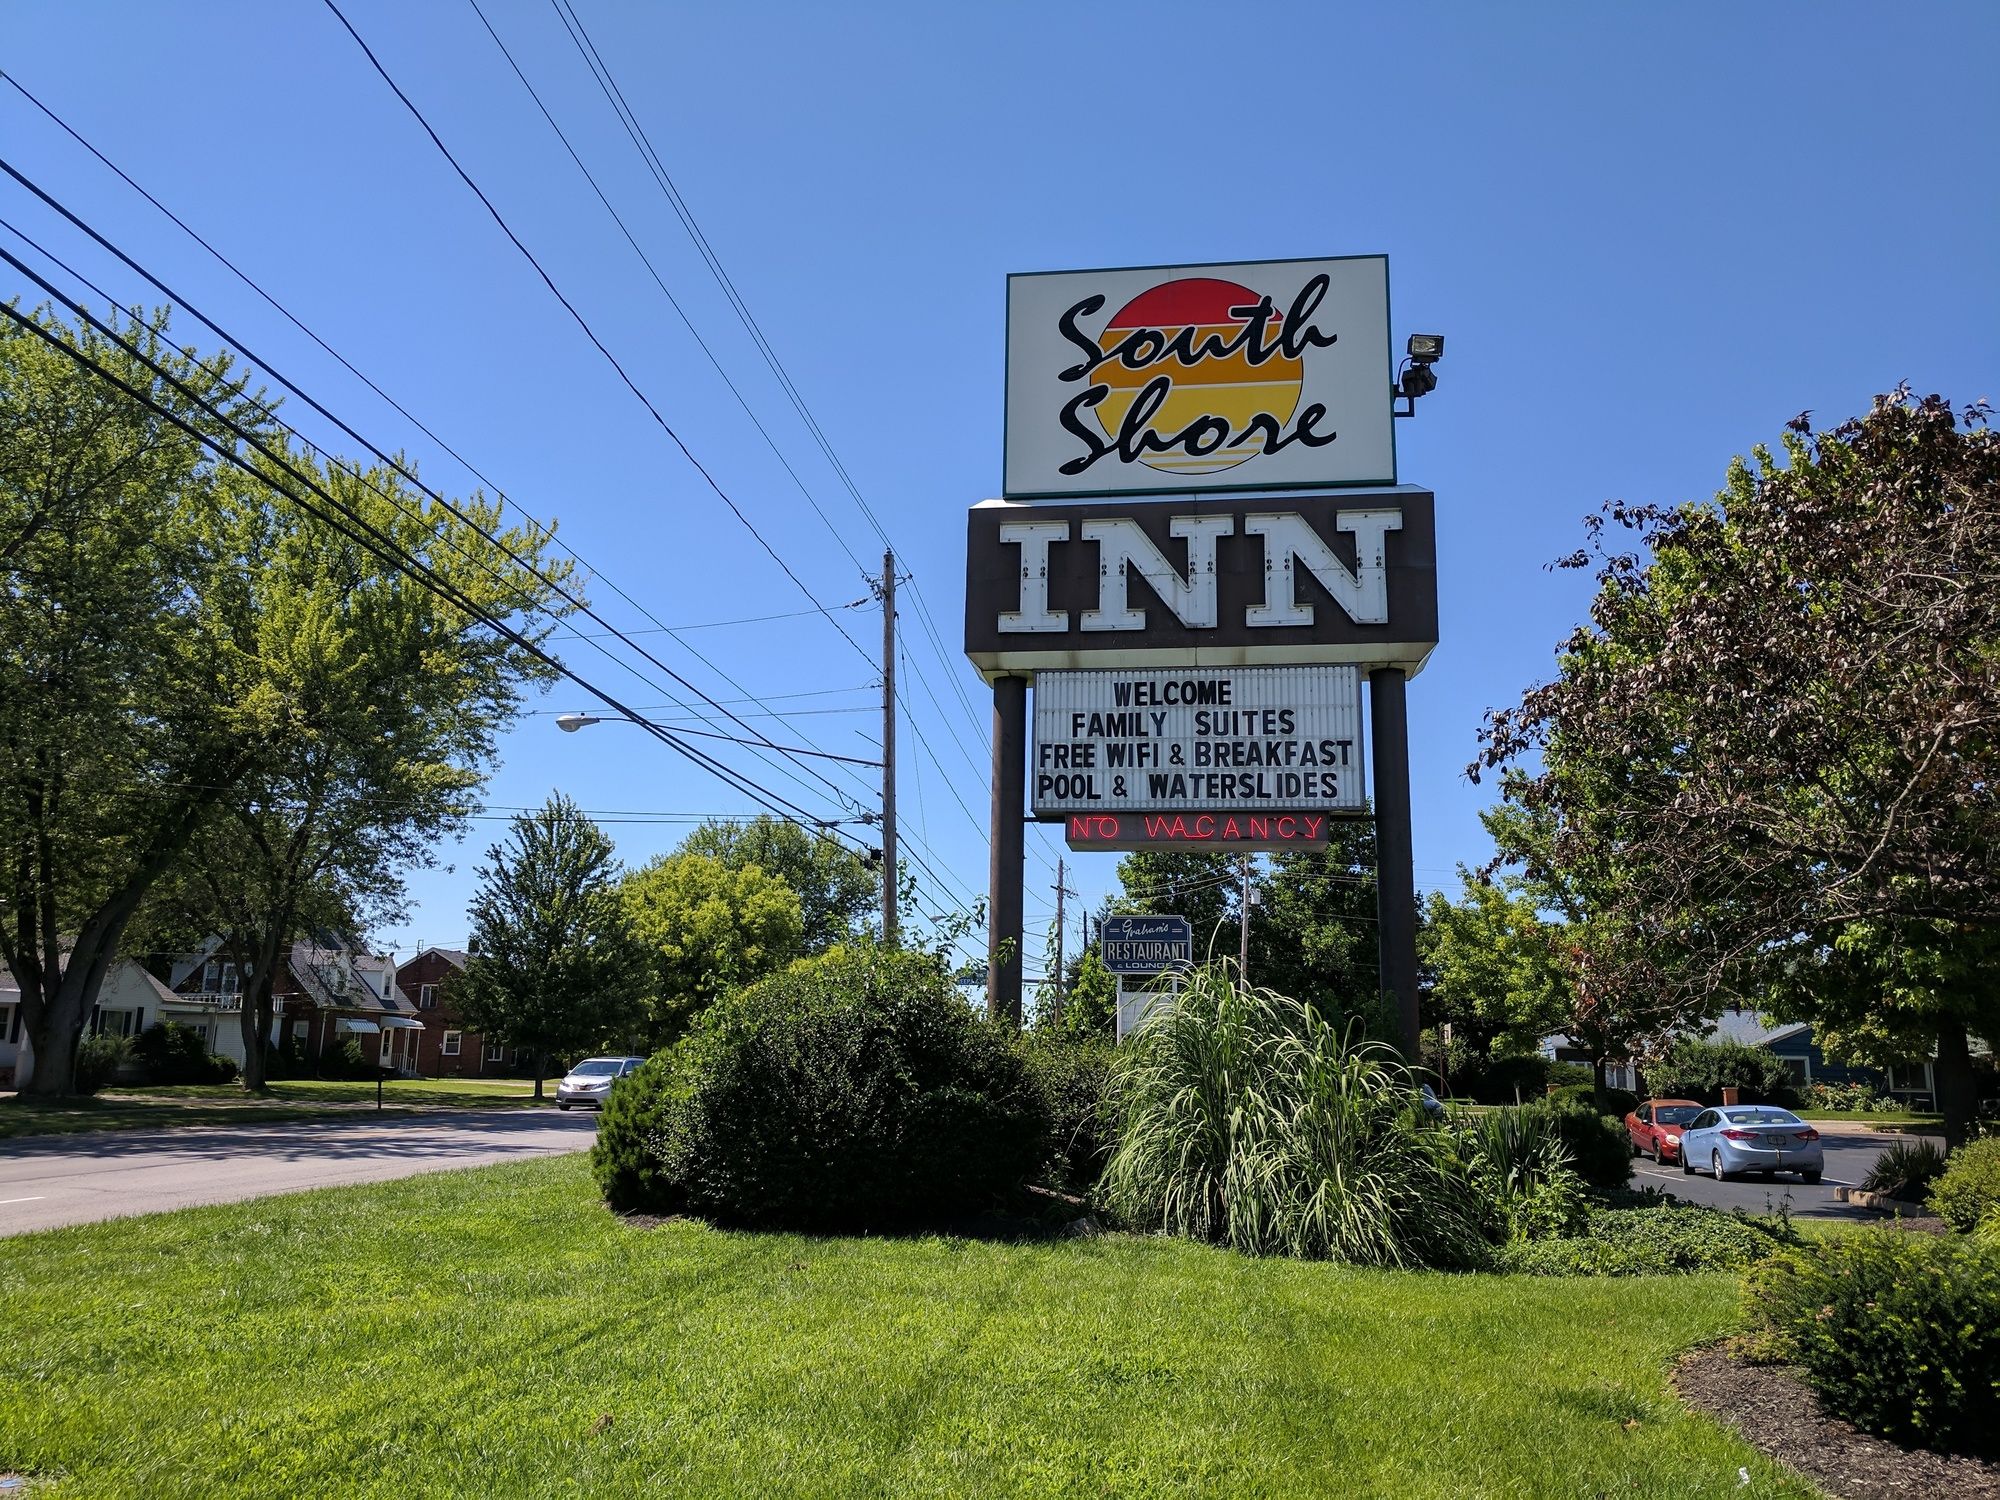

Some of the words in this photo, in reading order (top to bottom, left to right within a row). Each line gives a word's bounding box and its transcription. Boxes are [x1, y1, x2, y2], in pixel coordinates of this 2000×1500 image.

[1058, 273, 1337, 381] South
[1058, 376, 1337, 475] Shore
[997, 508, 1403, 633] INN
[1113, 680, 1232, 707] WELCOME
[1072, 711, 1167, 738] FAMILY
[1195, 709, 1295, 736] SUITES
[1039, 743, 1095, 769] FREE
[1106, 742, 1159, 768] WIFI
[1169, 743, 1185, 766] &
[1195, 739, 1353, 768] BREAKFAST
[1038, 774, 1101, 800] POOL
[1112, 775, 1128, 798] &
[1149, 772, 1338, 799] WATERSLIDES
[1072, 817, 1119, 839] NO
[1145, 816, 1322, 839] VACANCY
[1121, 919, 1169, 940] Graham's
[1107, 942, 1187, 960] RESTAURANT
